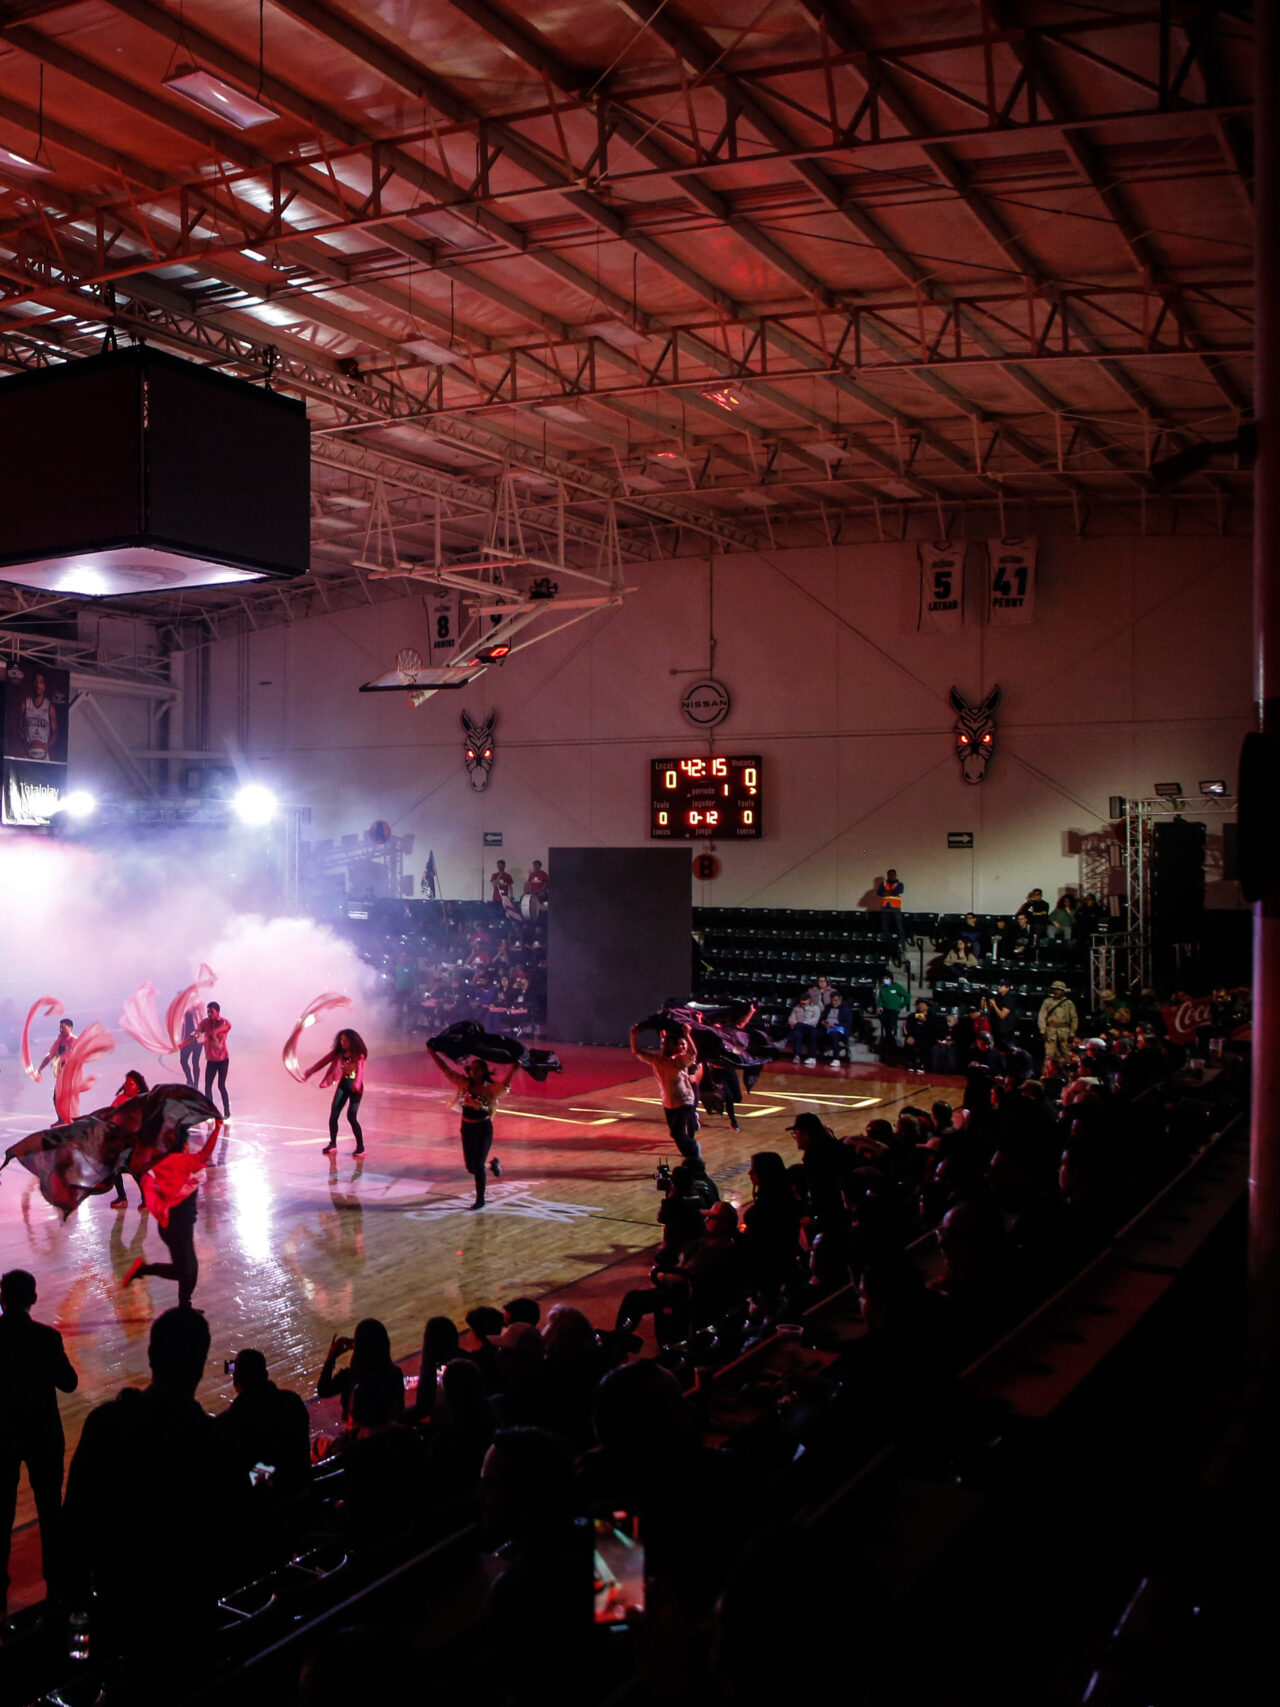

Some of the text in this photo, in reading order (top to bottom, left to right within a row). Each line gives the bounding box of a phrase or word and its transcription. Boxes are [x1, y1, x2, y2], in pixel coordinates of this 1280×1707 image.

[934, 571, 952, 599] 5
[993, 567, 1028, 596] 41
[437, 615, 450, 638] 8
[682, 699, 728, 709] NISSAN
[665, 770, 677, 789] 0
[745, 768, 757, 787] 0
[20, 782, 60, 802] Totalplay
[658, 811, 668, 825] 0
[743, 809, 753, 824] 0
[700, 856, 714, 878] B
